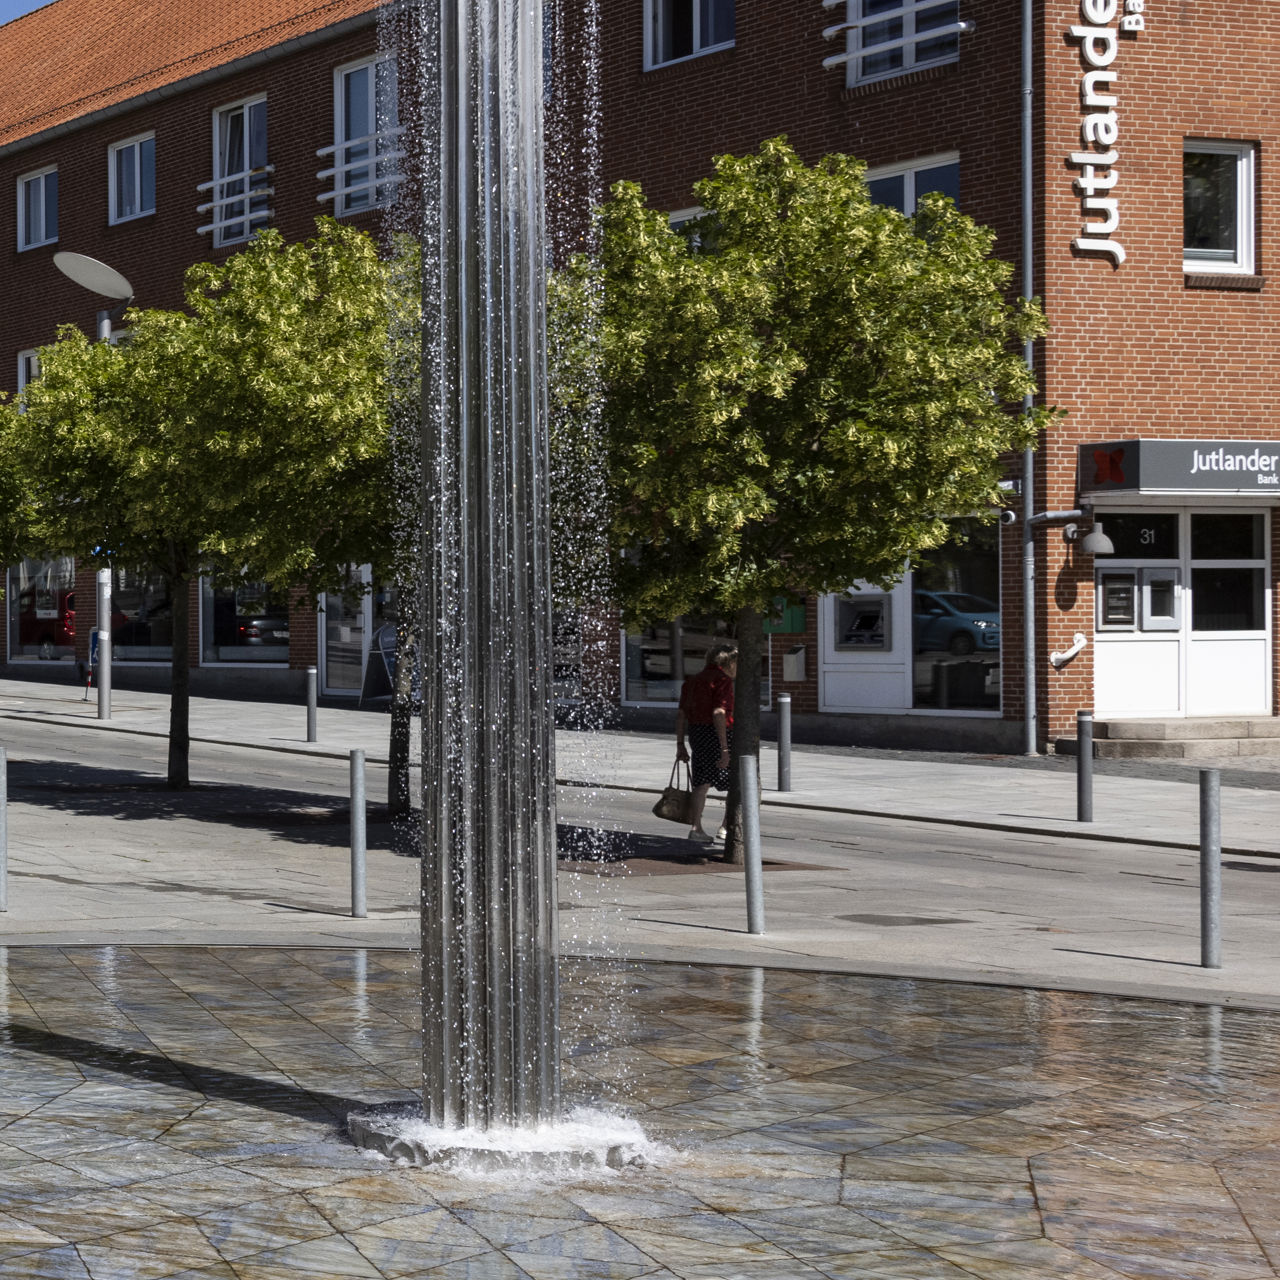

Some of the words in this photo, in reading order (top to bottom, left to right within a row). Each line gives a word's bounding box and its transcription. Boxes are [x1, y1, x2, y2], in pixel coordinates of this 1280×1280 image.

[1190, 448, 1279, 474] Jutlander
[1257, 473, 1279, 484] Bank
[1140, 529, 1155, 544] 31
